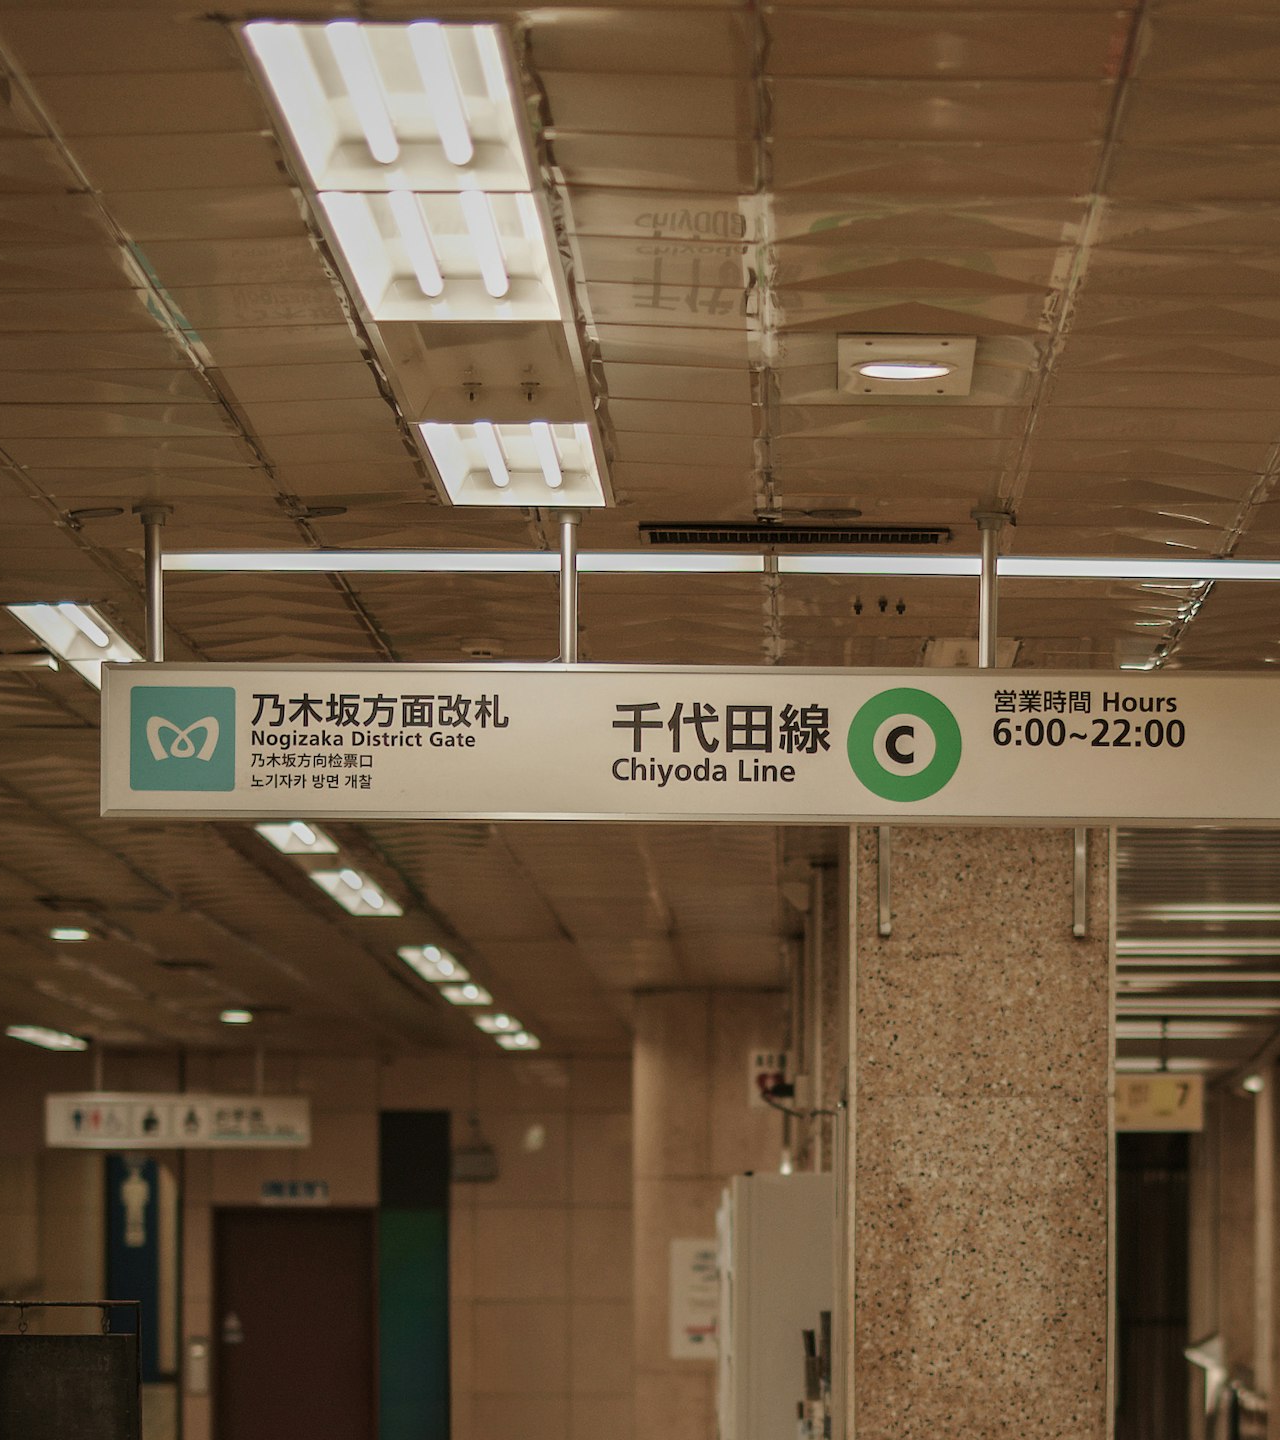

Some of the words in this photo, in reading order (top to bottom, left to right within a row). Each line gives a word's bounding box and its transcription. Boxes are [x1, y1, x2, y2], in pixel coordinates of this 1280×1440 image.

[250, 693, 510, 729] 乃木坂方面改札
[994, 689, 1091, 714] 営業時間
[1103, 691, 1177, 714] Hours
[251, 730, 344, 750] Nogizaka
[351, 730, 423, 748] District
[429, 731, 476, 748] Gate
[612, 701, 831, 754] 千代田線
[884, 725, 915, 765] C
[250, 752, 374, 769] 乃木坂方向检票口
[612, 757, 727, 786] Chiyoda
[738, 757, 796, 782] Line
[250, 773, 307, 790] 노기자카
[312, 773, 340, 790] 방면
[344, 773, 373, 790] 개찰
